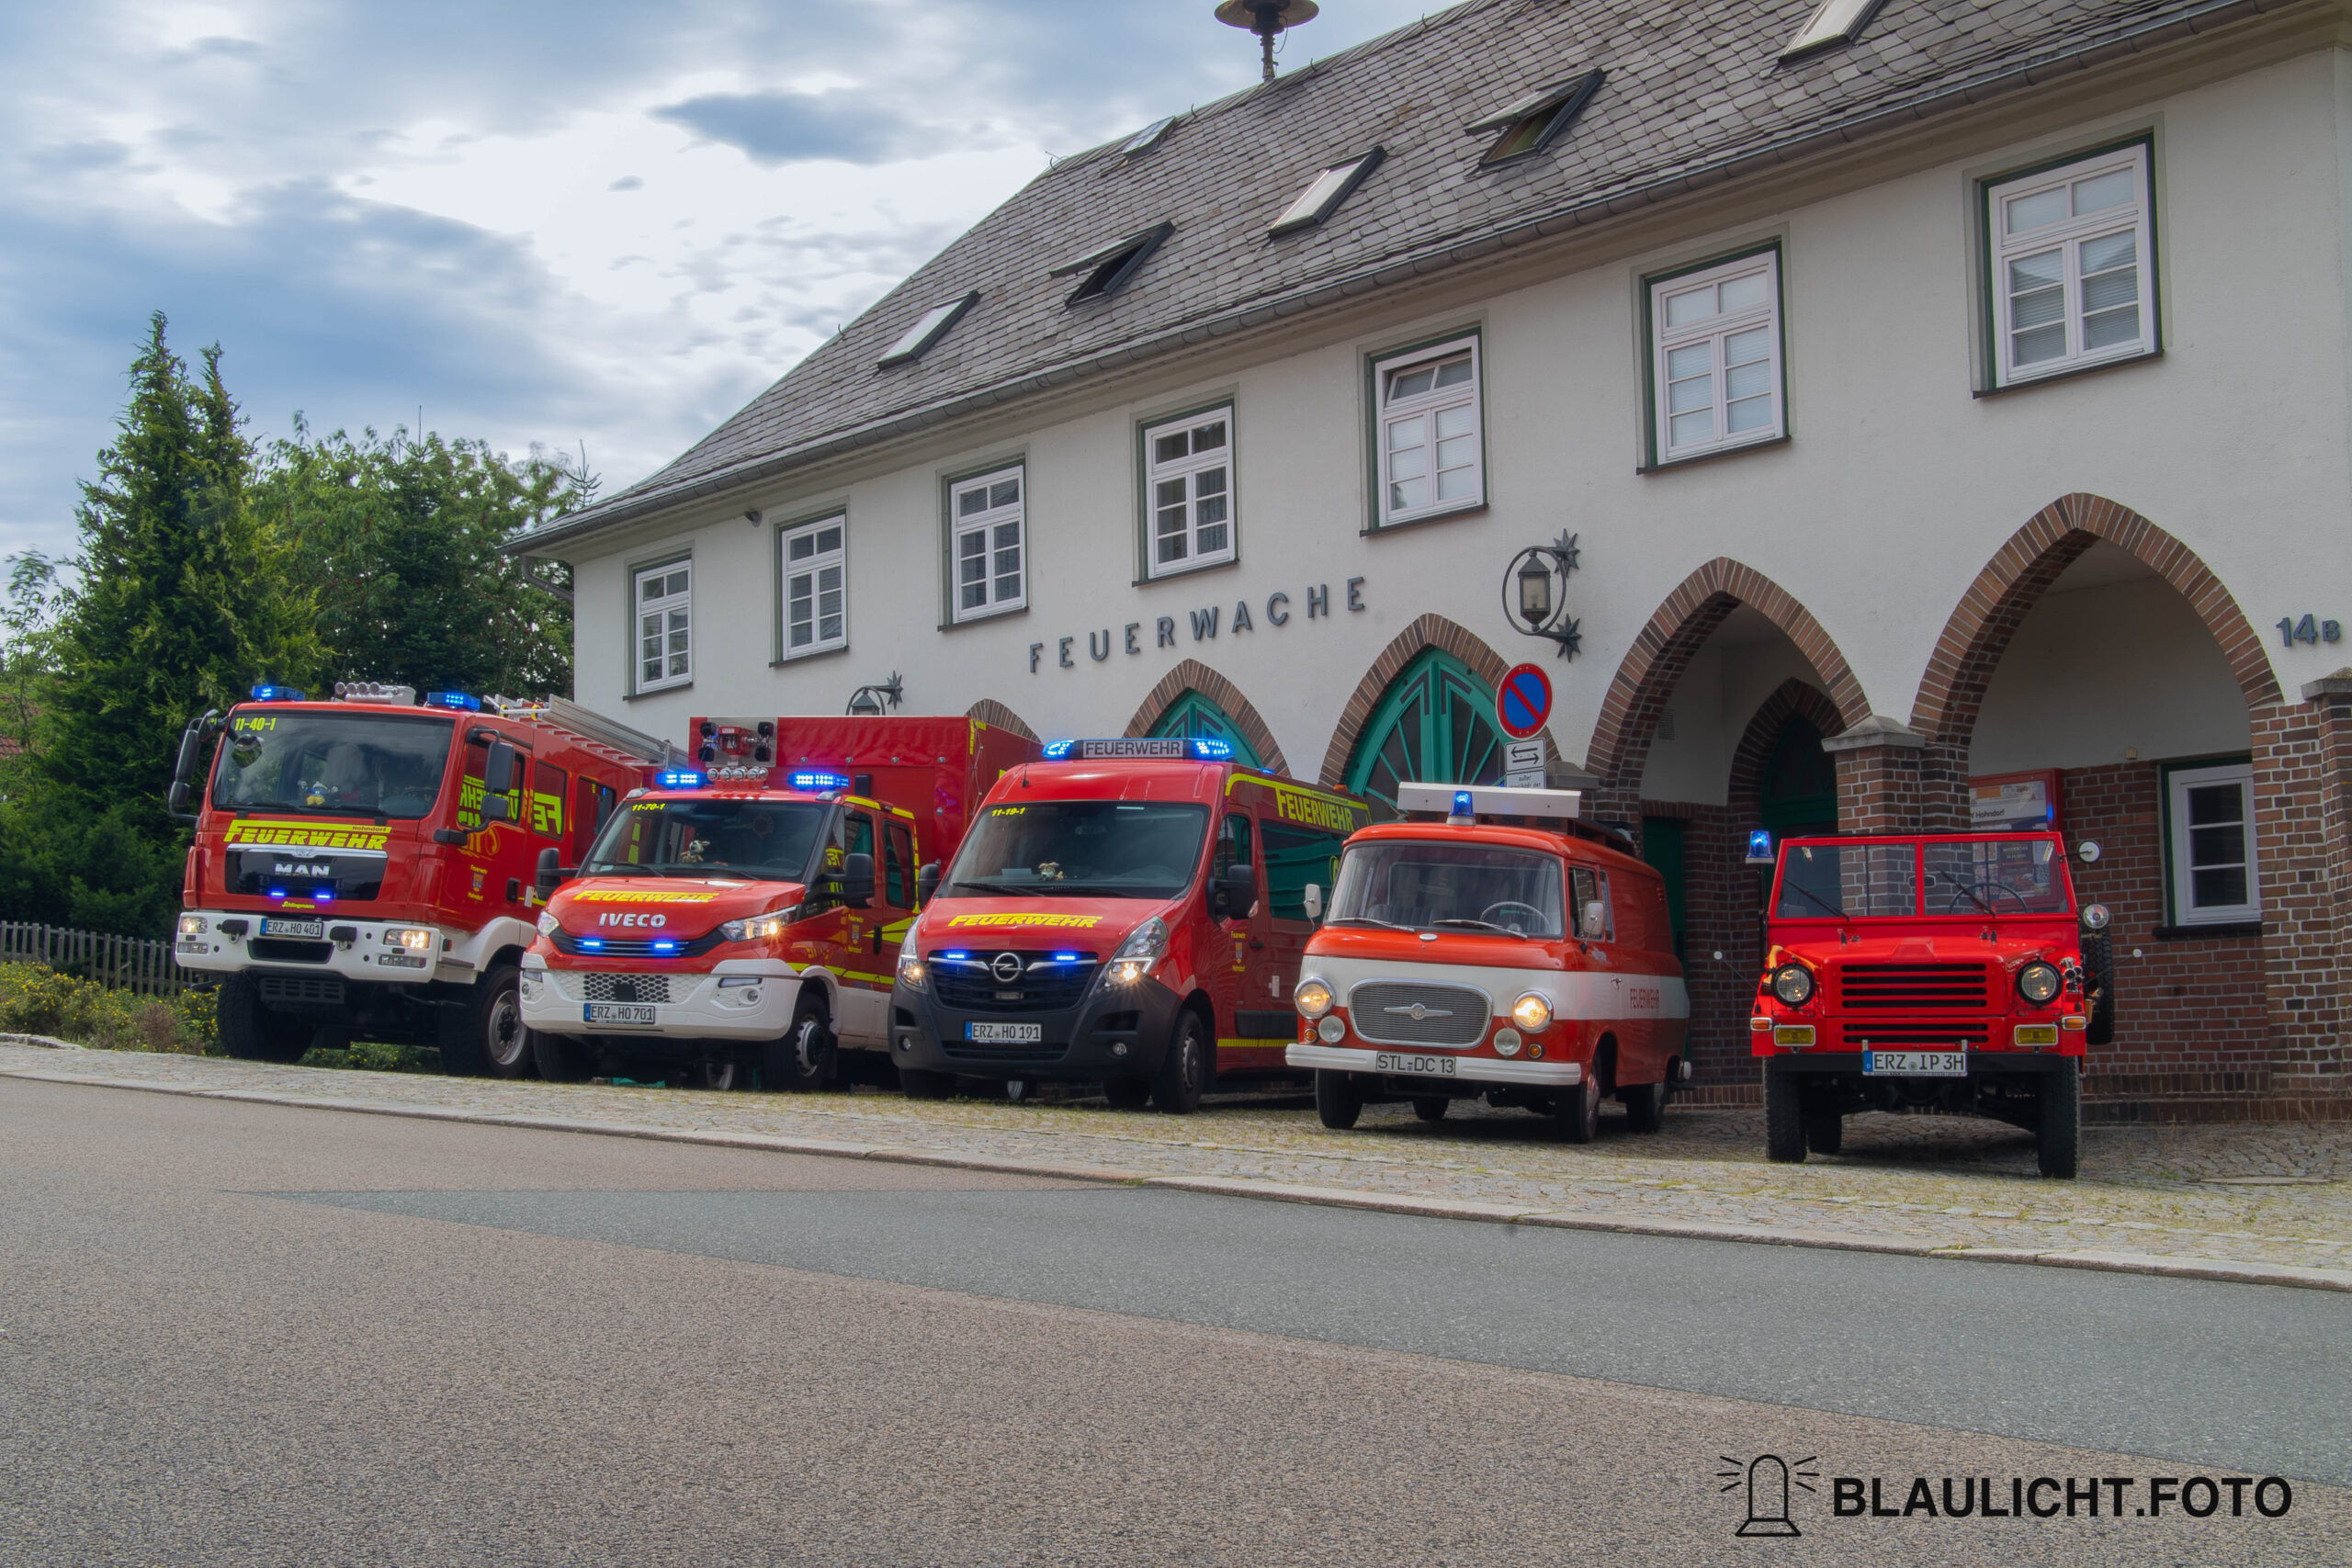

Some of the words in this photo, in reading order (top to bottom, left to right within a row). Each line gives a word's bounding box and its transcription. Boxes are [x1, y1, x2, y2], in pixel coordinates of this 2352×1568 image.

[1029, 576, 1365, 673] FEUERWACHE
[235, 717, 277, 731] 11-40-1
[1085, 741, 1181, 755] FEUERWEHR
[632, 803, 665, 812] 11-70-1
[991, 807, 1026, 817] 11-19-1
[1275, 787, 1355, 833] FEUERWEHR
[1975, 808, 2005, 818] Hohndorf
[223, 819, 392, 850] FEUERWEHR
[275, 863, 331, 877] MAN
[573, 889, 720, 904] FEUERWEHR
[598, 912, 667, 928] IVECO
[947, 912, 1103, 929] FEUERWEHR
[266, 921, 284, 934] ERZ
[290, 923, 303, 935] HO
[303, 924, 321, 937] 401
[1629, 987, 1660, 1010] FEUERWEHR
[591, 1006, 611, 1019] ERZ
[617, 1007, 631, 1020] HO
[634, 1007, 653, 1021] 701
[972, 1024, 993, 1038] ERZ
[1001, 1025, 1016, 1039] HO
[1019, 1026, 1040, 1040] 191
[1440, 1058, 1454, 1074] 13
[1873, 1054, 1906, 1070] ERZ
[1919, 1054, 1939, 1070] IP
[1943, 1054, 1964, 1070] 3H
